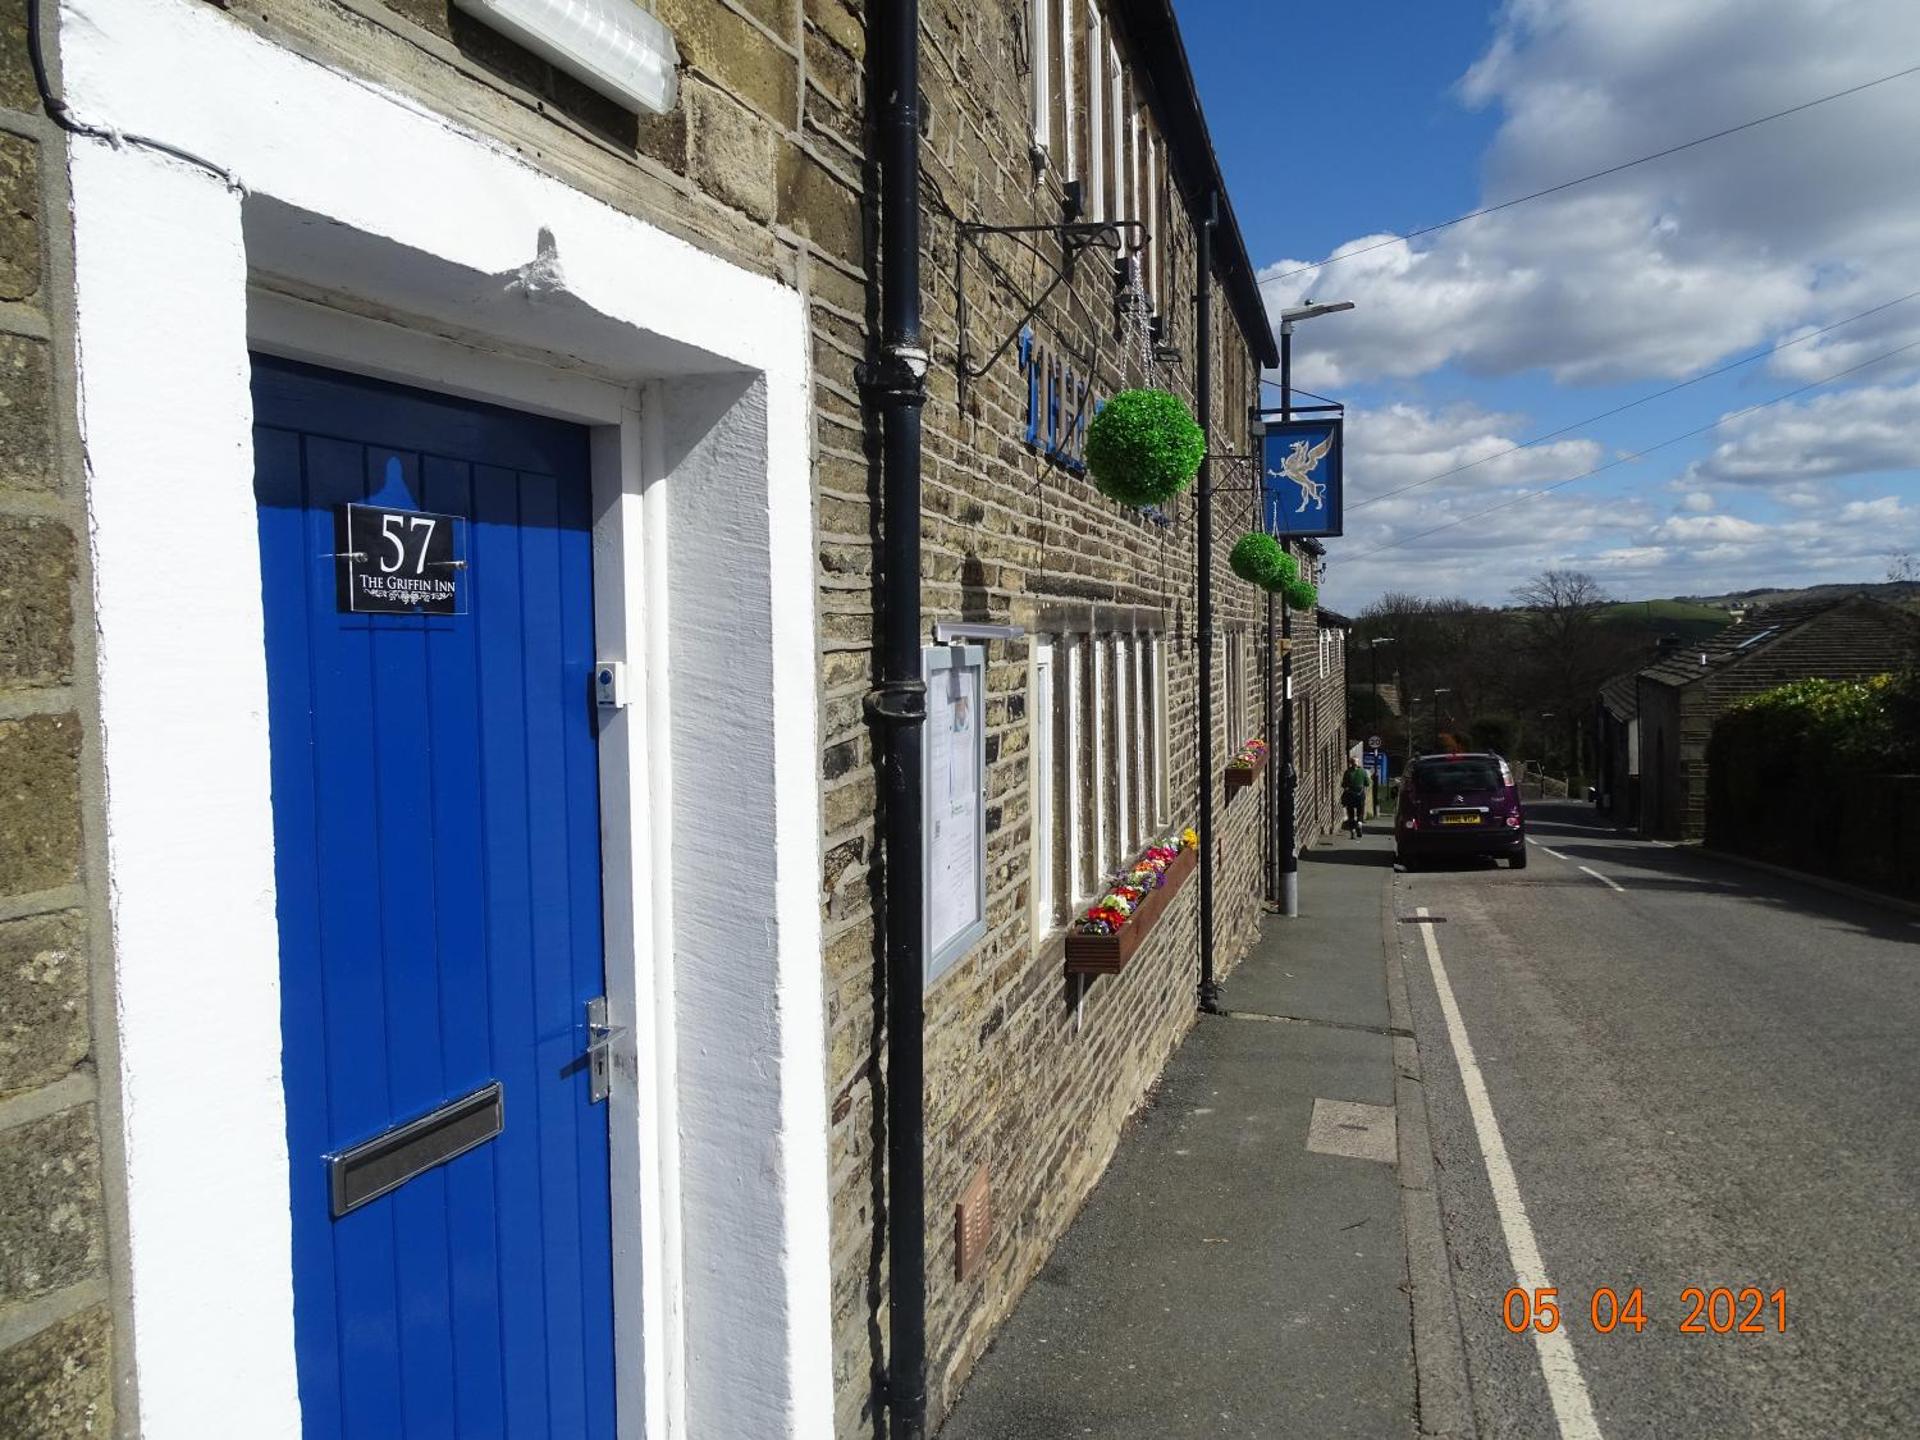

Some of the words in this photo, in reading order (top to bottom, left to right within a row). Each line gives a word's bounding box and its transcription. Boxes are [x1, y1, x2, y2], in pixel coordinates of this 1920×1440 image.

[380, 513, 436, 575] 57
[360, 574, 384, 589] THE
[387, 576, 431, 591] GRIFFIN
[435, 579, 456, 592] INN
